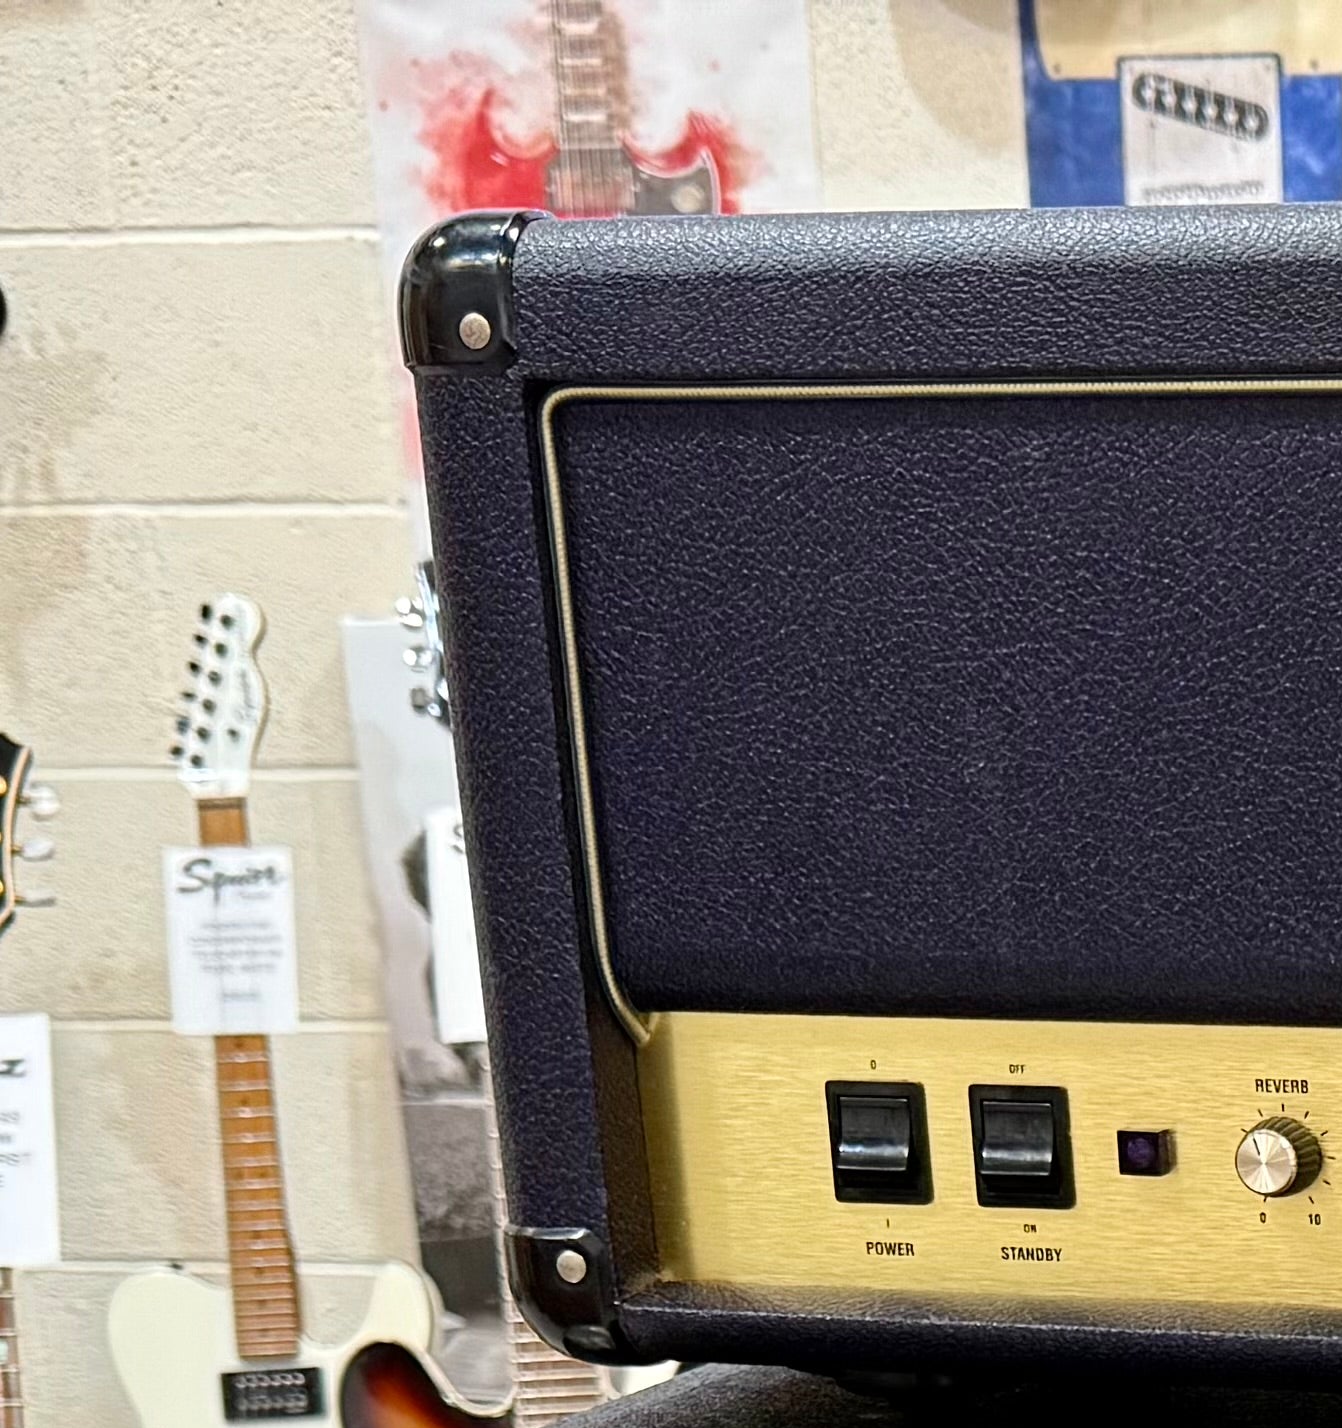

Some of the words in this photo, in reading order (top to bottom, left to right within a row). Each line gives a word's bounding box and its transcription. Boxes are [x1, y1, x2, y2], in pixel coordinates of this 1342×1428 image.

[1008, 1064, 1025, 1074] OFF
[1254, 1078, 1309, 1094] REVERB
[1259, 1211, 1267, 1224] 0
[1308, 1213, 1321, 1226] 10
[1023, 1223, 1037, 1233] ON
[865, 1241, 915, 1257] POWER
[1000, 1246, 1062, 1262] STANDBY
